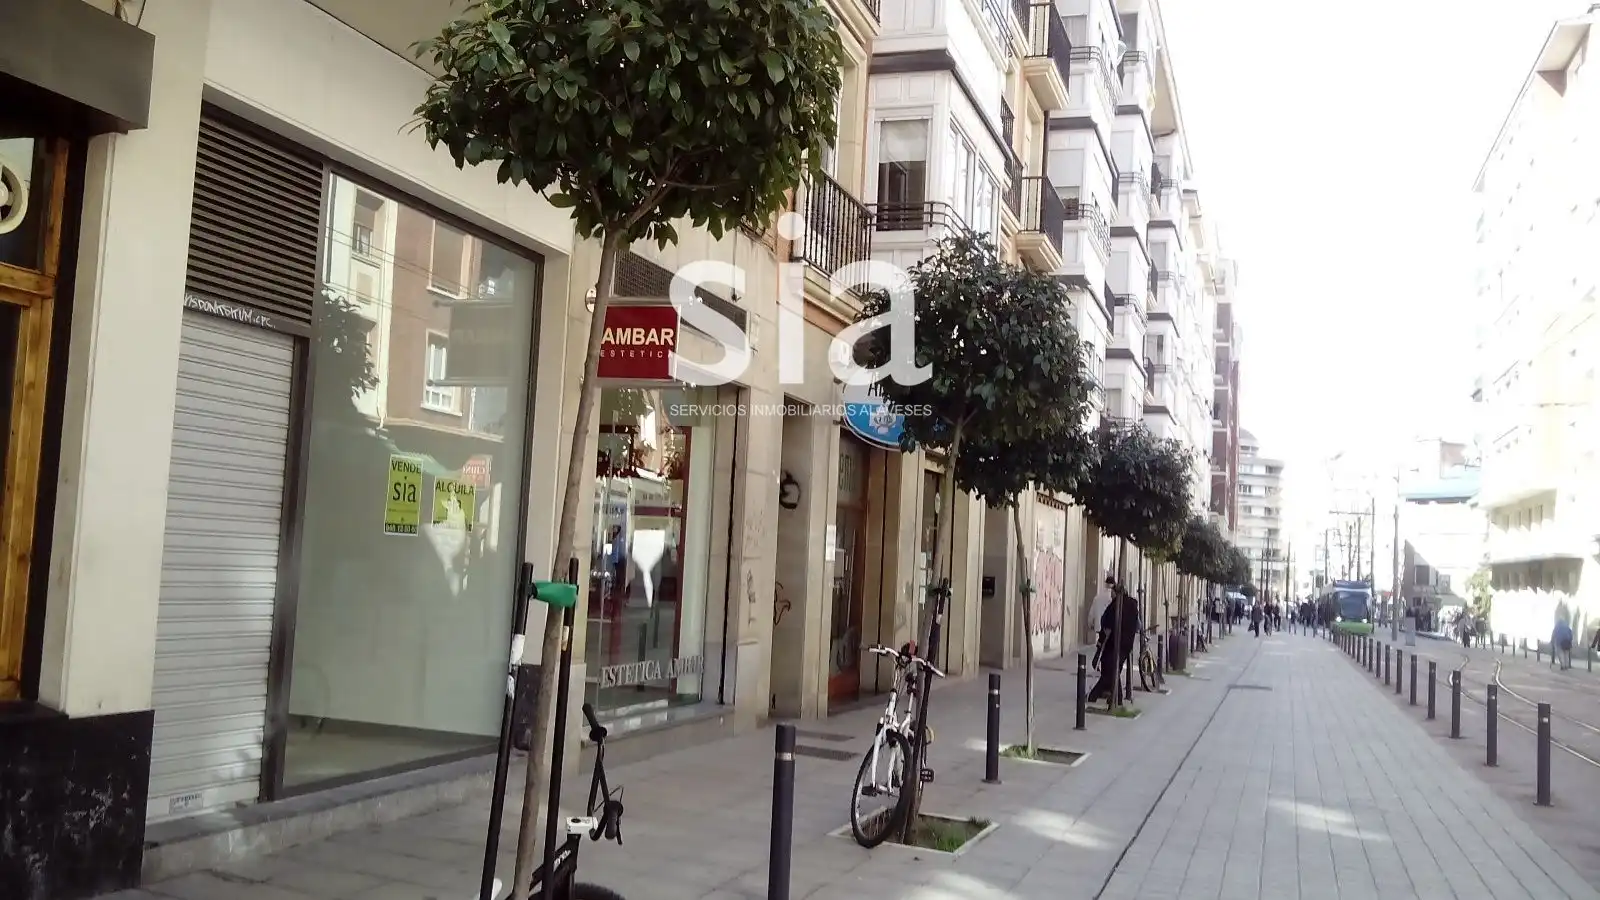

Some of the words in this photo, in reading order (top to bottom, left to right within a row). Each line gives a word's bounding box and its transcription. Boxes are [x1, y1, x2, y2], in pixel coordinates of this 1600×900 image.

[600, 327, 674, 346] AMBAR
[391, 460, 421, 474] VENDE
[393, 476, 416, 503] sia
[601, 660, 662, 688] ESTETICA
